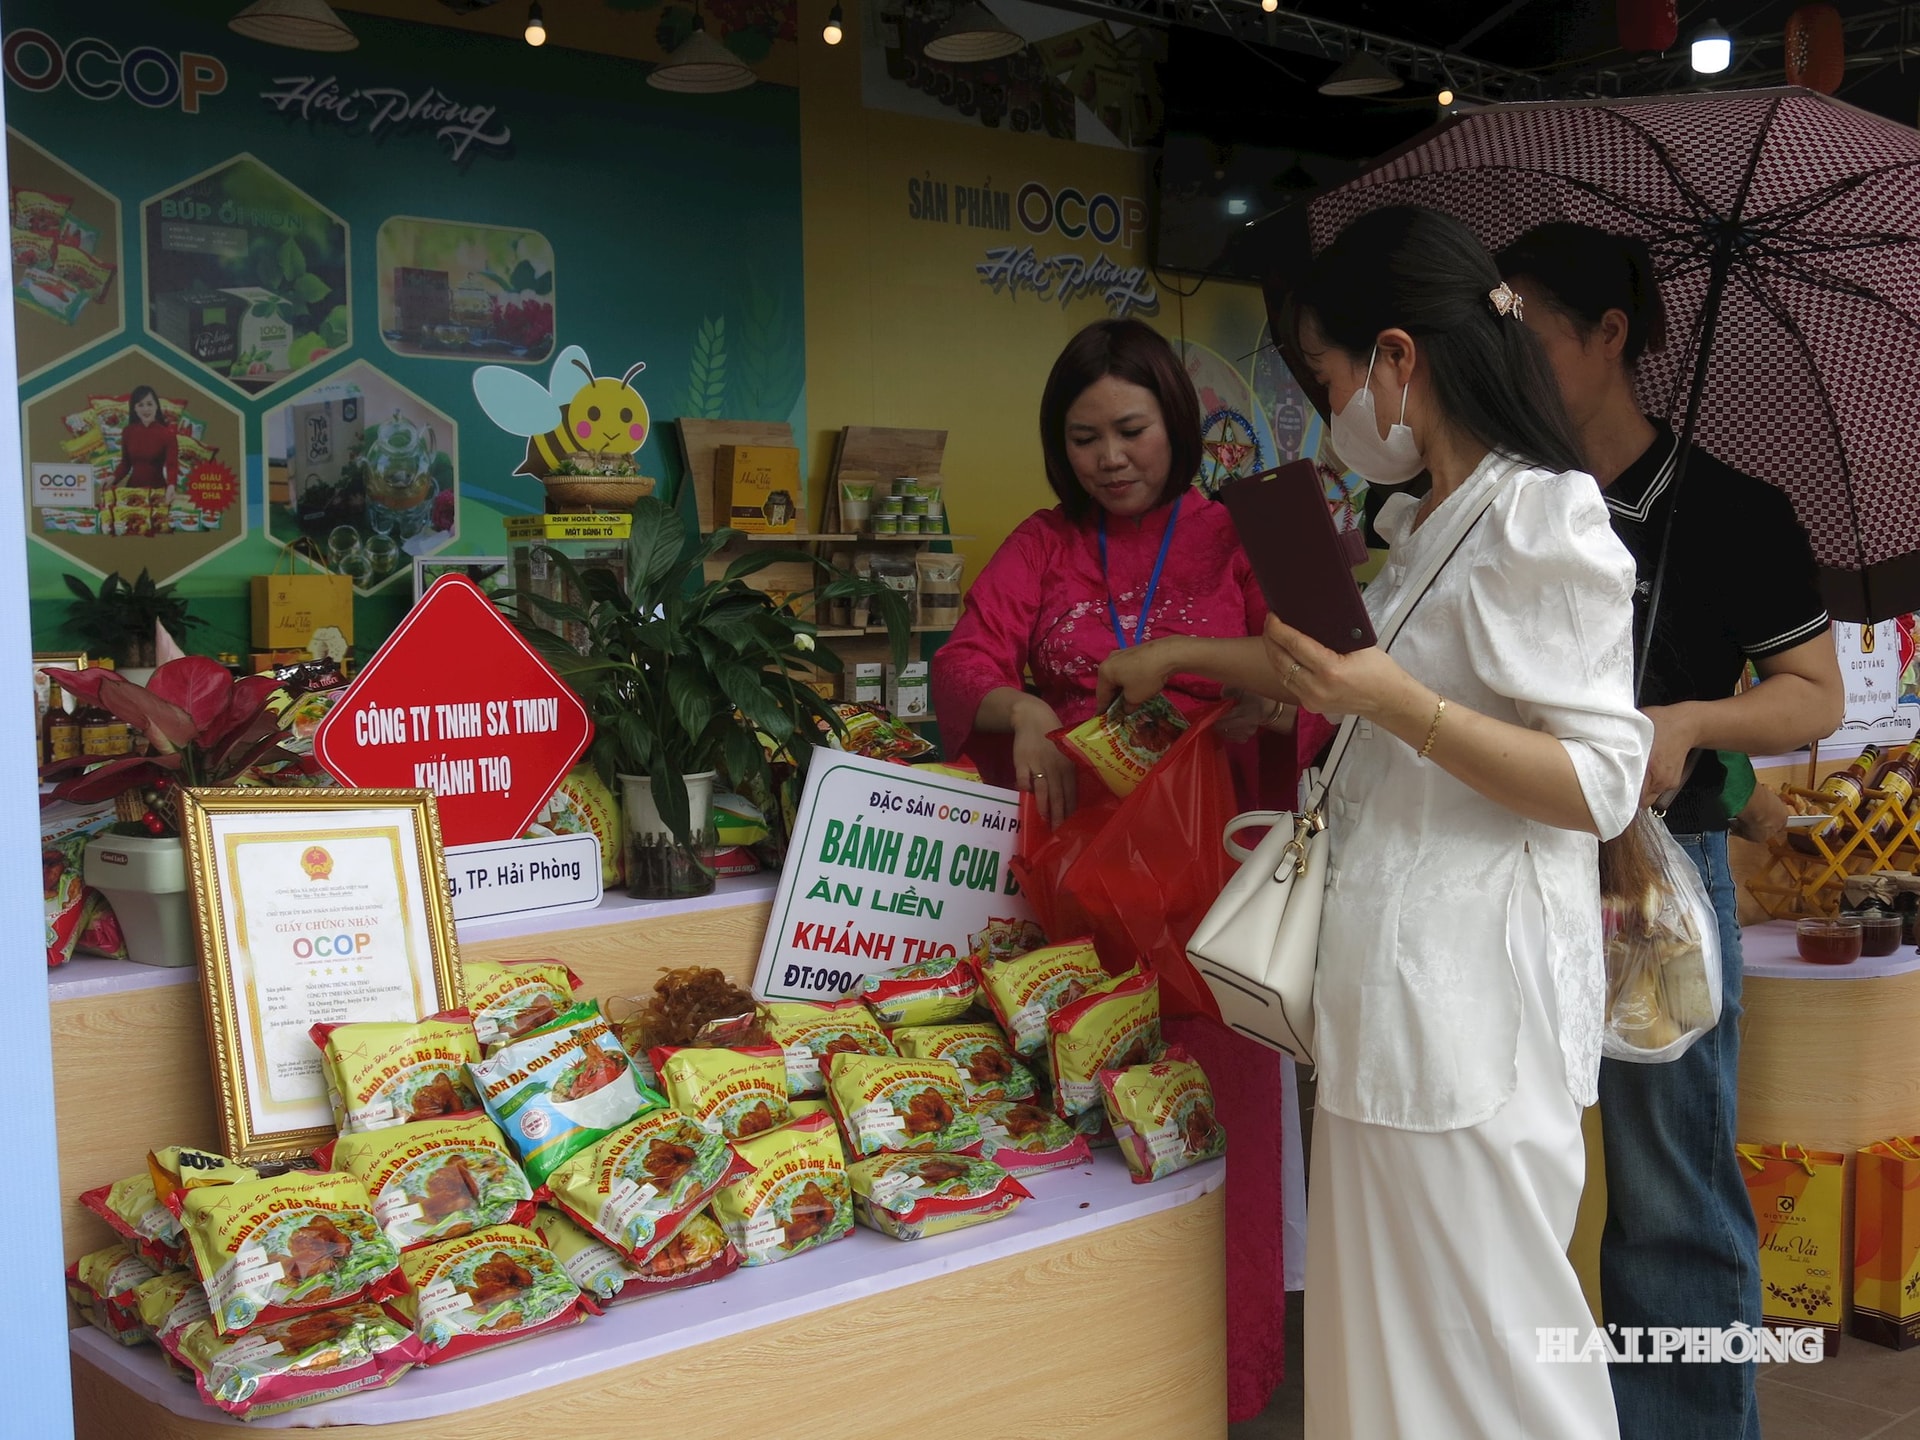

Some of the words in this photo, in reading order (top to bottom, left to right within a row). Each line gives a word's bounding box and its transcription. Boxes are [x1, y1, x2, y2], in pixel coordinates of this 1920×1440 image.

[2, 27, 228, 114] OCOP
[259, 75, 361, 121] Hải
[360, 85, 512, 161] Phòng
[161, 197, 212, 220] BÚP
[908, 170, 948, 222] SẢN
[955, 175, 1010, 231] PHẨM
[1016, 180, 1150, 249] OCOP
[975, 244, 1052, 288] Hải
[1051, 252, 1158, 316] Phòng
[259, 325, 287, 335] 100%
[309, 444, 329, 458] Sen
[40, 474, 87, 487] OCOP
[191, 482, 224, 491] OMEGA
[201, 491, 221, 500] DHA
[355, 702, 407, 747] CÔNG
[410, 706, 431, 742] TY
[436, 702, 482, 740] TNHH
[486, 701, 510, 736] SX
[512, 698, 559, 734] TMDV
[414, 754, 475, 797] KHÁNH
[479, 755, 512, 798] THỌ
[869, 790, 903, 814] ĐẶC
[906, 795, 936, 818] SẢN
[938, 804, 981, 825] OCOP
[982, 810, 1006, 832] HẢI
[819, 815, 904, 876] BÁNH
[904, 834, 944, 884] ĐA
[948, 844, 1000, 893] CUA
[466, 869, 493, 891] TP.
[497, 862, 524, 887] Hải
[530, 857, 581, 883] Phòng
[805, 875, 863, 907] ĂN
[870, 886, 945, 920] LIỀN
[275, 919, 302, 933] GIẤY
[305, 918, 345, 931] CHỨNG
[348, 915, 379, 929] NHẬN
[792, 920, 896, 962] KHÁNH
[293, 933, 371, 959] OCOP
[357, 1075, 384, 1104] Bánh
[381, 1064, 401, 1078] Đa
[400, 1054, 414, 1068] Cá
[416, 1048, 432, 1062] Rô
[508, 1068, 529, 1087] ĐA
[527, 1054, 553, 1073] CUA
[673, 1073, 685, 1082] kt
[863, 1082, 884, 1102] Bánh
[882, 1075, 894, 1088] Đa
[893, 1070, 907, 1081] Cá
[908, 1067, 920, 1079] Rô
[947, 1075, 961, 1089] Ăn
[662, 1109, 679, 1122] Ăn
[697, 1098, 718, 1122] Bánh
[715, 1090, 729, 1103] Đa
[727, 1081, 739, 1095] Cá
[740, 1079, 752, 1092] Rô
[776, 1084, 787, 1097] Ăn
[611, 1143, 623, 1157] Cá
[621, 1132, 634, 1148] Rô
[370, 1168, 395, 1197] Bánh
[391, 1155, 408, 1170] Đa
[407, 1144, 424, 1158] Cá
[424, 1138, 442, 1151] Rô
[479, 1134, 496, 1148] Ăn
[602, 1158, 613, 1175] Đa
[598, 1173, 611, 1195] Bánh
[743, 1189, 764, 1217] Bánh
[764, 1173, 776, 1189] Đa
[774, 1163, 786, 1179] Cá
[786, 1159, 799, 1175] Rô
[827, 1153, 842, 1169] Ăn
[226, 1224, 256, 1253] Bánh
[249, 1211, 269, 1229] Đa
[268, 1197, 287, 1213] Cá
[286, 1195, 303, 1209] Rô
[341, 1197, 361, 1211] Ăn
[1759, 1232, 1789, 1252] Hoa
[416, 1263, 440, 1288] Bánh
[434, 1252, 452, 1265] Đa
[450, 1241, 465, 1255] Cá
[466, 1236, 484, 1250] Rô
[519, 1234, 537, 1247] Ăn
